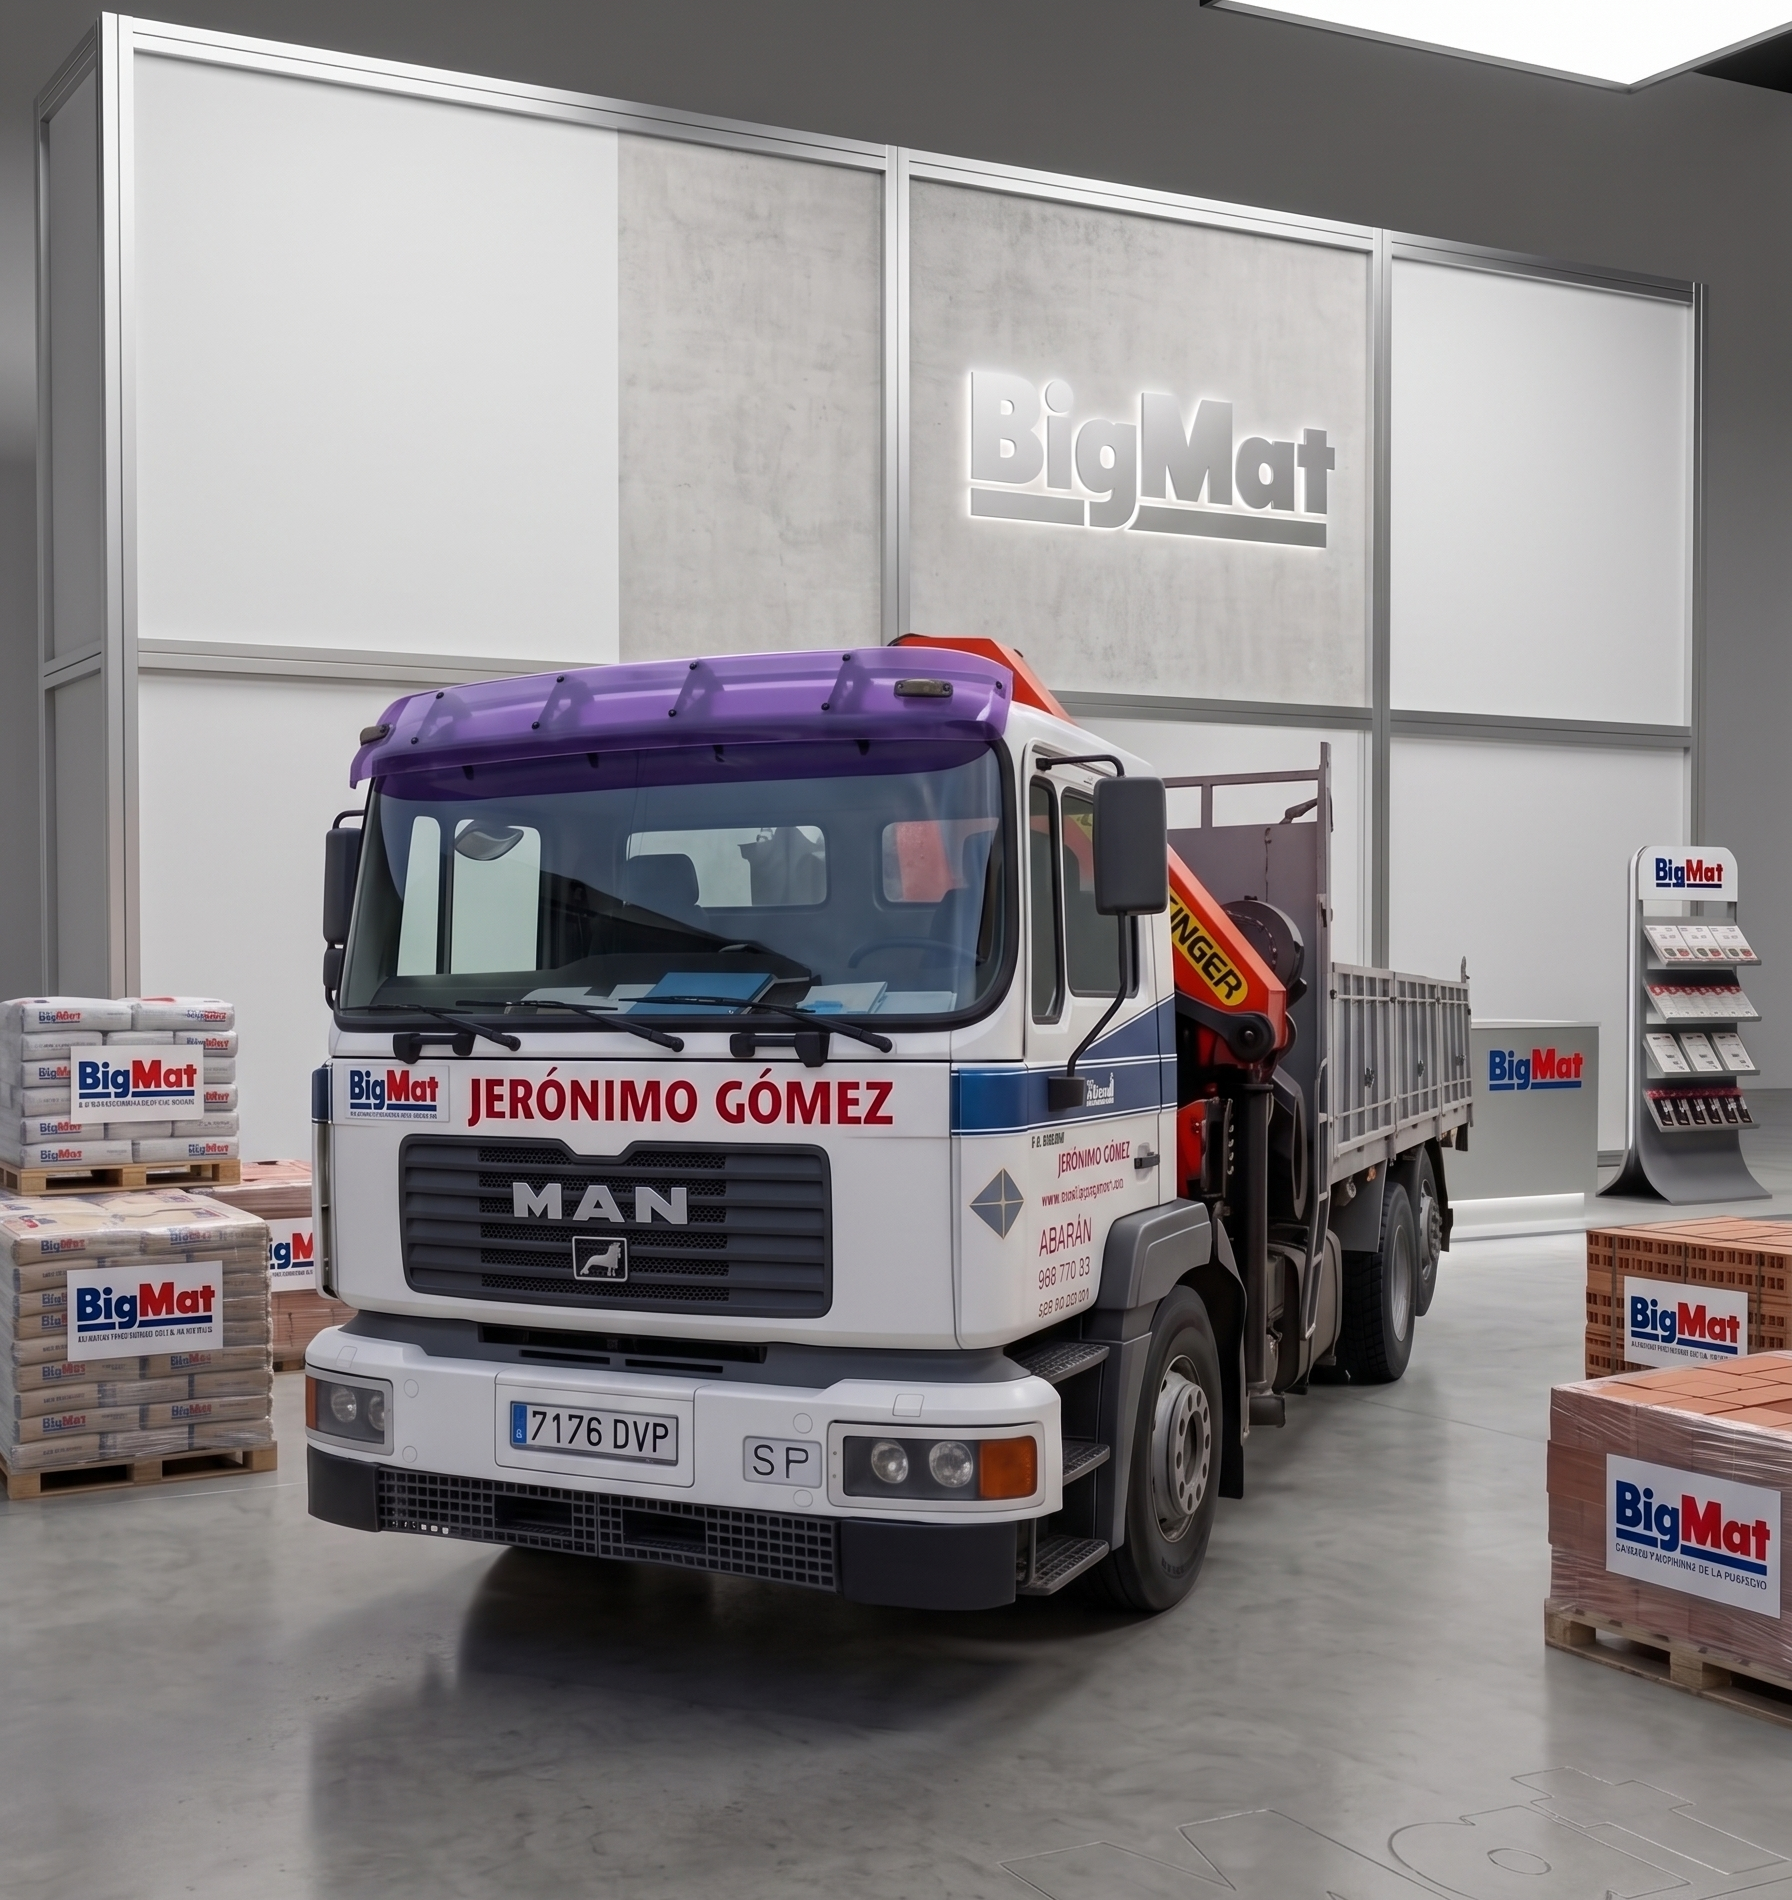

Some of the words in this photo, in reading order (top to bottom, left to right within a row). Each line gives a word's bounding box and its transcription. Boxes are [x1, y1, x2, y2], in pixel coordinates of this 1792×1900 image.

[970, 371, 1335, 529] BigMat
[1655, 857, 1723, 888] BigMat
[78, 1059, 197, 1099] BigMat
[350, 1069, 438, 1110] BigMat
[1489, 1048, 1583, 1090] BigMat
[468, 1066, 698, 1127] JERÓNIMO
[716, 1068, 894, 1125] GÓMEZ
[1057, 1146, 1101, 1179] JERÓNIMO
[513, 1182, 689, 1226] MAN
[1039, 1213, 1092, 1257] ABARÁN
[77, 1281, 215, 1330] BigMat
[1630, 1295, 1740, 1344] BigMat
[531, 1410, 603, 1447] 7176
[613, 1418, 669, 1453] DVP
[1616, 1479, 1770, 1562] BigMat
